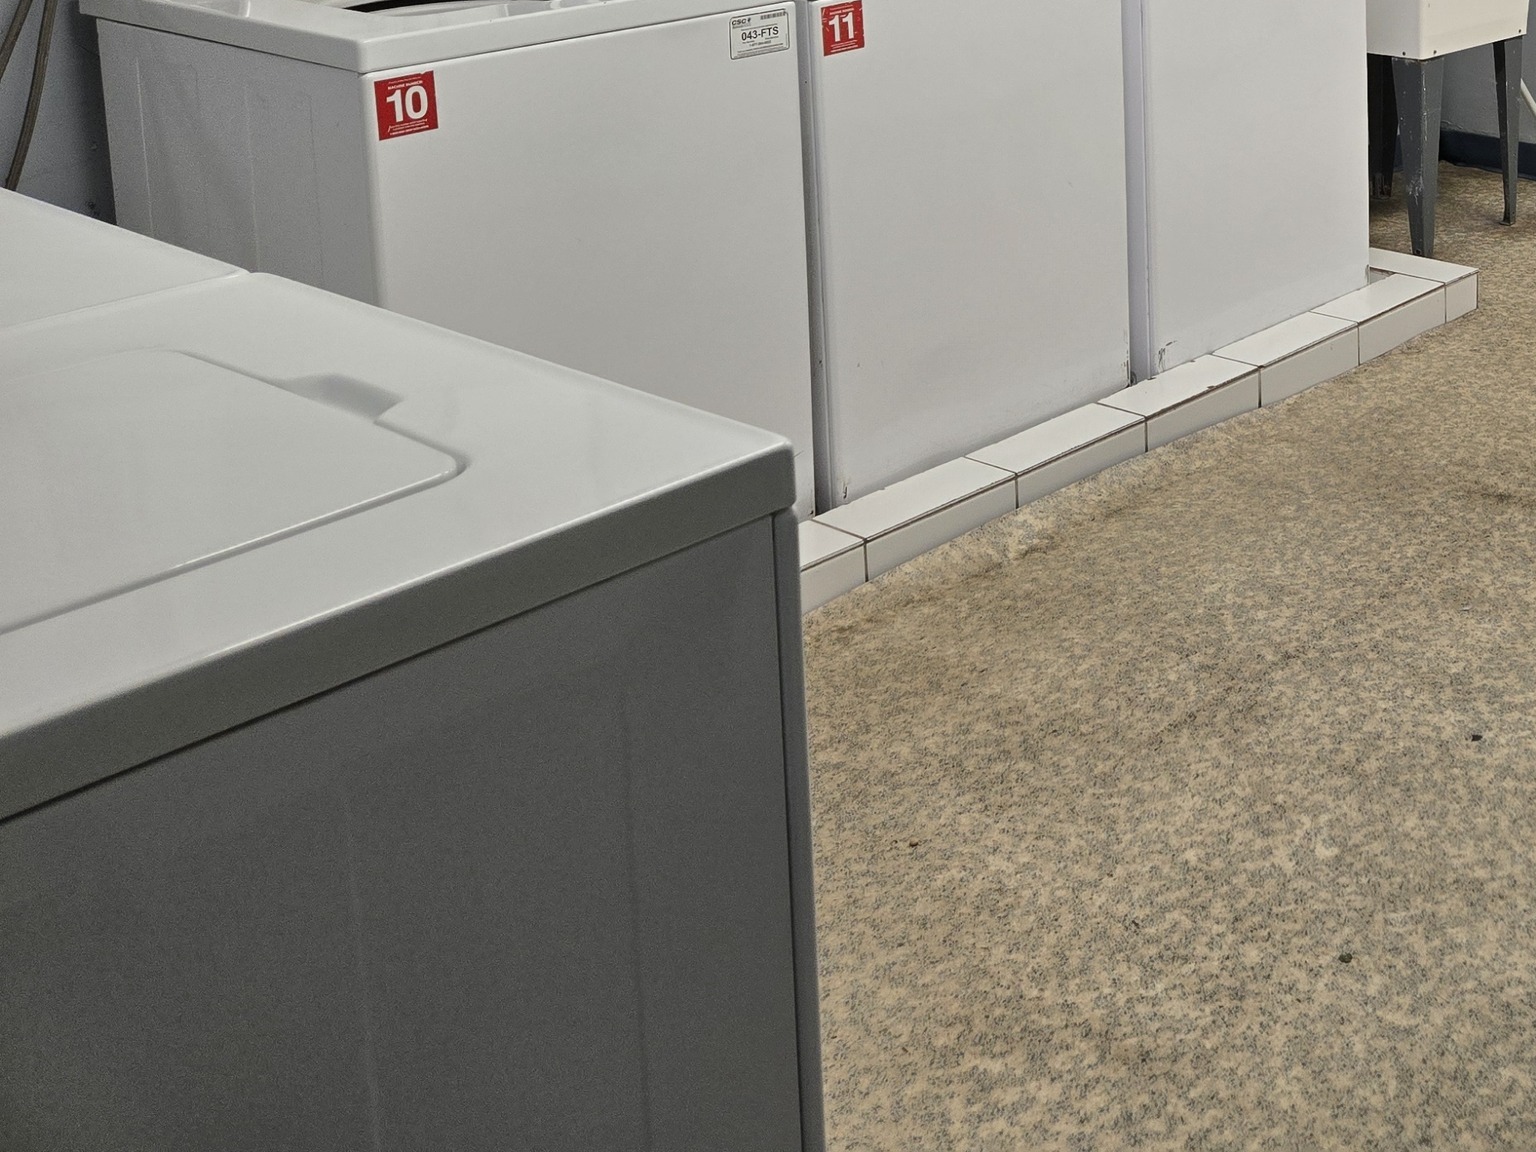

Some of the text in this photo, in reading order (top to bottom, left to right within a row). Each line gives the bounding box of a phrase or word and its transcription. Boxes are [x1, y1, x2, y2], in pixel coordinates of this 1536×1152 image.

[731, 18, 747, 26] CSC
[741, 26, 779, 41] 043-FTS
[828, 11, 855, 43] 11
[386, 85, 429, 123] 10
